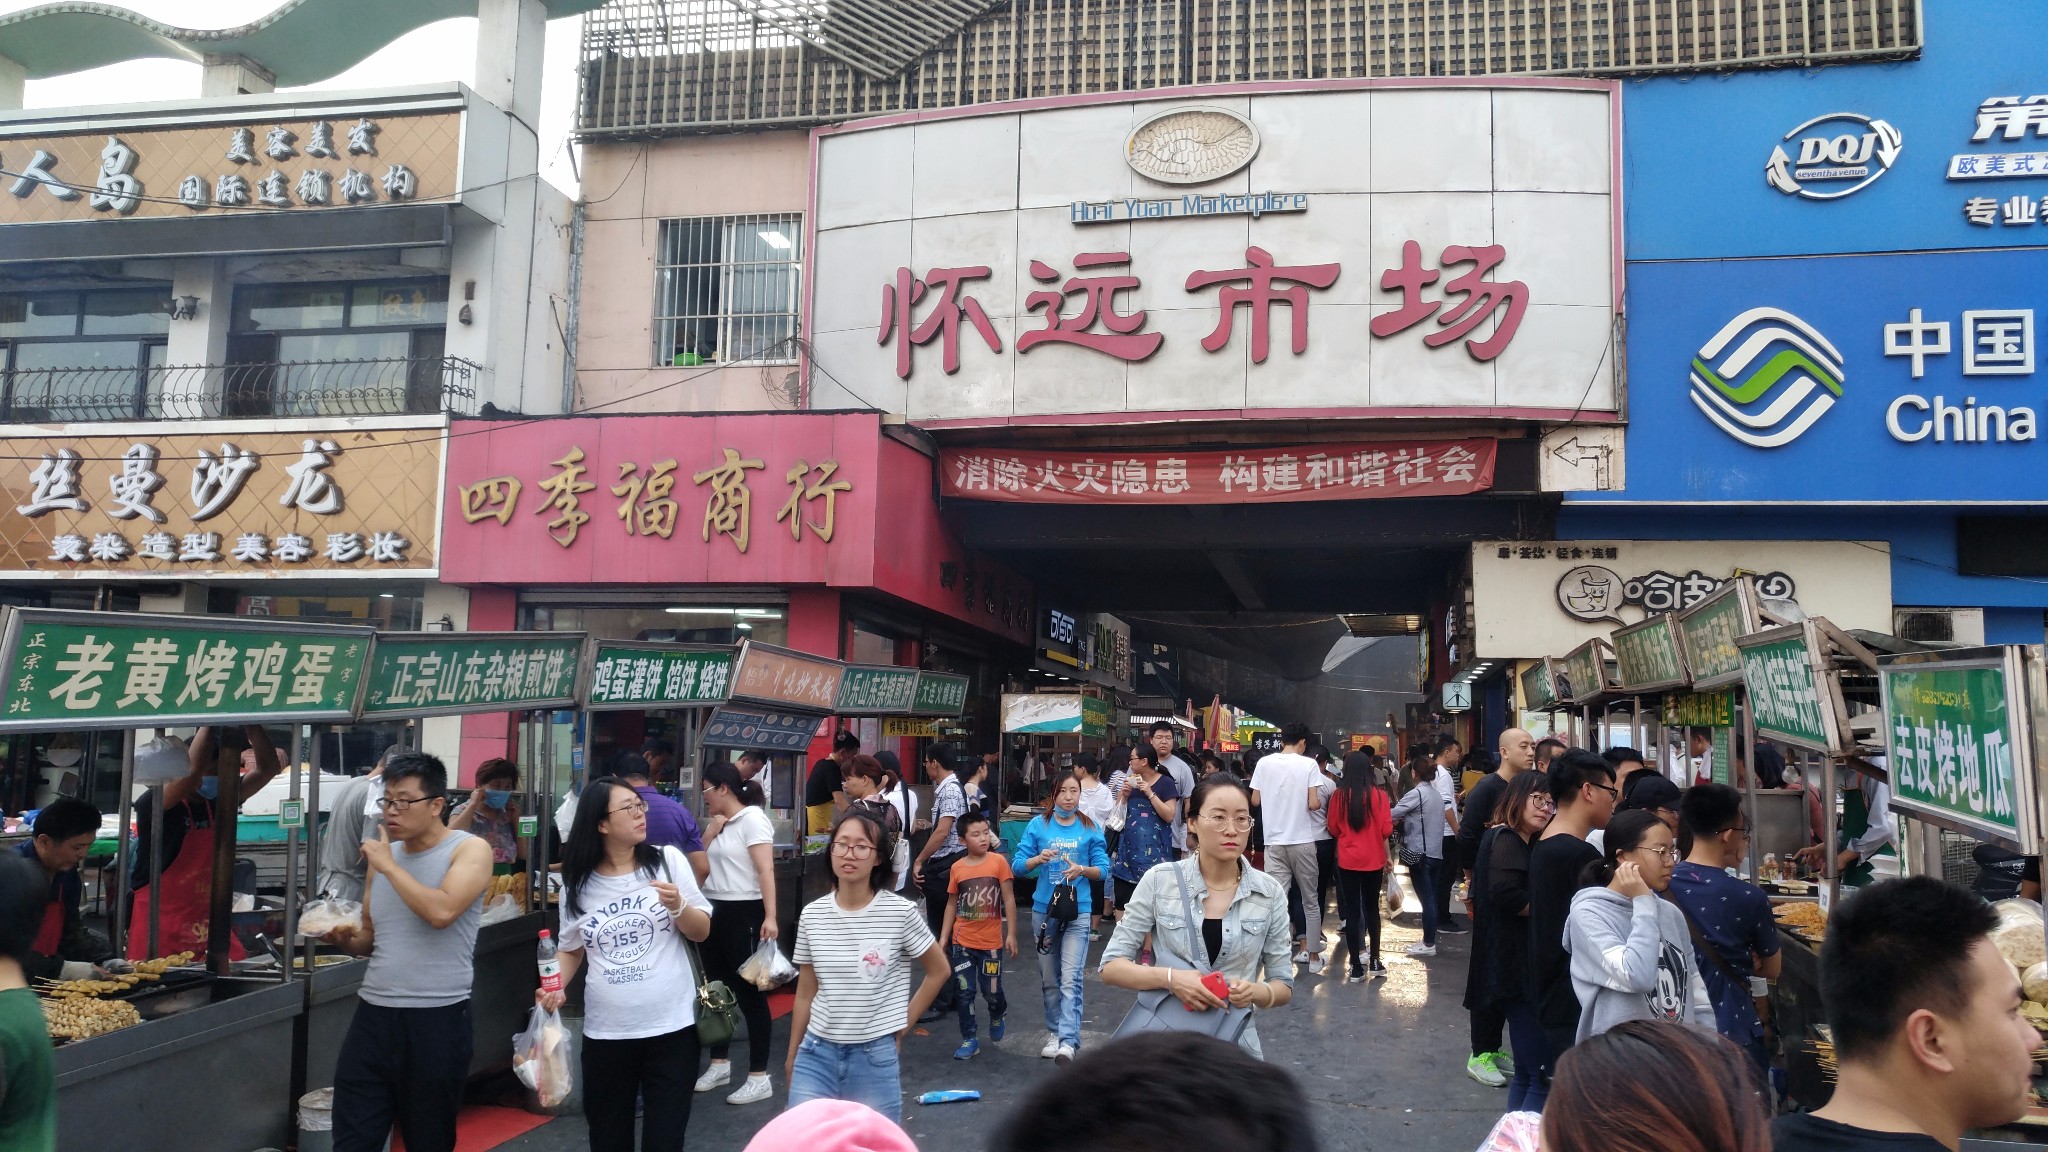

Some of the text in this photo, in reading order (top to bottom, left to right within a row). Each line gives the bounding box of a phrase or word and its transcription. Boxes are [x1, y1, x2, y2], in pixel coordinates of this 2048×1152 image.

[226, 118, 374, 162] 美容美发
[1797, 133, 1878, 166] DQJ
[178, 164, 412, 206] 国际连锁机构
[1957, 155, 2048, 175] 欧美式
[1071, 200, 1114, 222] Huai
[1124, 198, 1172, 218] Yuan
[1966, 195, 2048, 225] 专业
[877, 239, 1530, 379] 怀远市场
[1883, 308, 2036, 379] 中国
[1886, 394, 2037, 443] China
[17, 440, 340, 521] 丝曼沙龙
[955, 445, 1477, 494] 消除火灾隐患 构建和谐社会
[458, 446, 852, 552] 四季福商行
[49, 532, 407, 561] 烫染 造型 美容 彩妆
[9, 632, 47, 713] 正宗东北
[49, 635, 334, 709] 老黄烤鸡蛋
[334, 644, 358, 705] 老字号
[386, 649, 564, 706] 正宗山东杂粮煎饼
[592, 656, 729, 701] 鸡蛋灌饼 馅饼 烧饼
[1896, 714, 2012, 818] 去皮烤地瓜
[583, 895, 671, 949] NEW YORK CITY
[602, 918, 647, 937] RUCKER
[612, 931, 639, 948] 155
[603, 963, 651, 976] BASKETBALL
[608, 943, 646, 960] LEAGUE
[986, 961, 999, 974] W
[607, 972, 644, 985] CLASSICS
